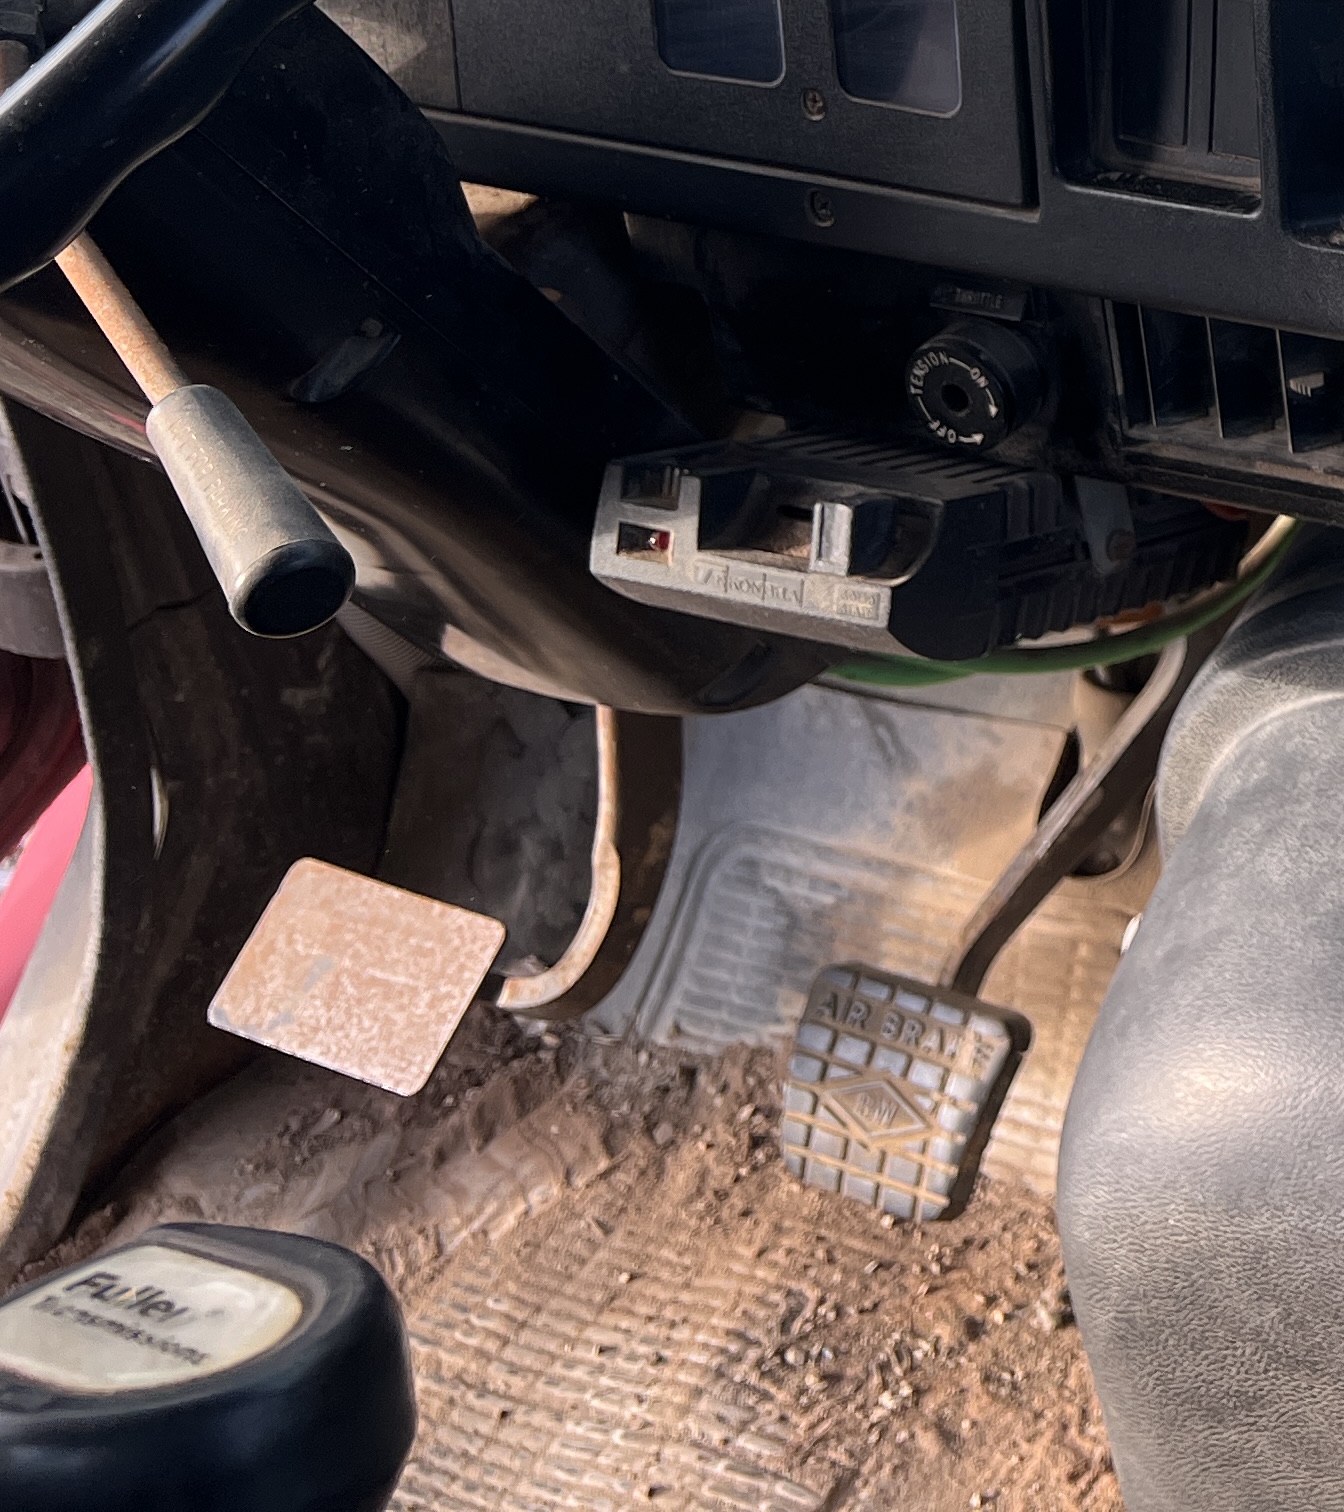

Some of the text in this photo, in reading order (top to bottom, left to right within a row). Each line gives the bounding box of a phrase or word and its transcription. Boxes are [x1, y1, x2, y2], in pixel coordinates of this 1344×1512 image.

[909, 350, 950, 395] TENSION
[970, 367, 990, 389] ON
[928, 419, 957, 444] OFF
[816, 992, 871, 1029] AIR
